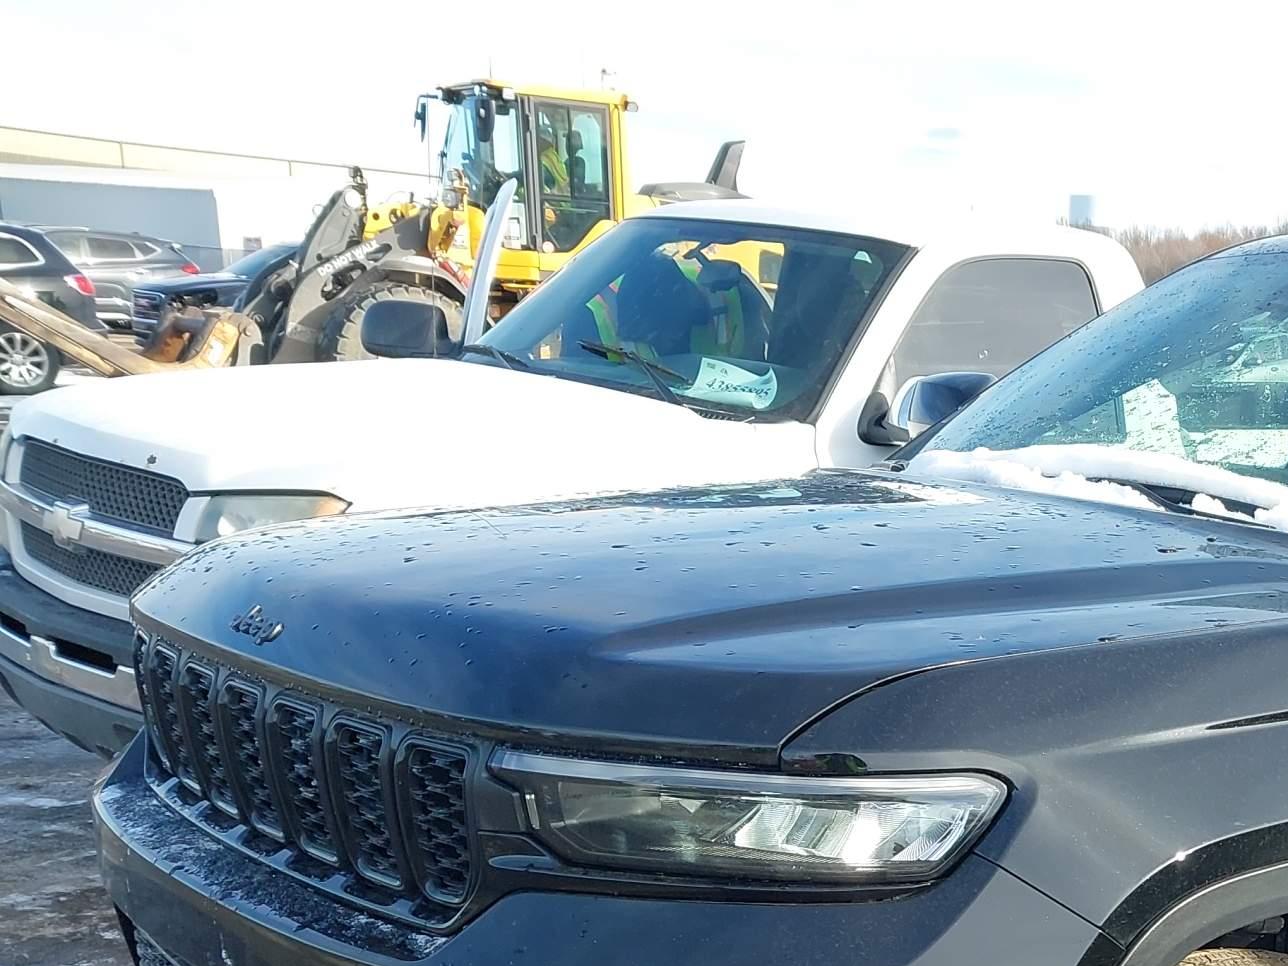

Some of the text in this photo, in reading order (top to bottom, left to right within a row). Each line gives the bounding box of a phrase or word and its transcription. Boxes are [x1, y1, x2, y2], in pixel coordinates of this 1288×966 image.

[317, 240, 380, 277] DO NOT WALK
[231, 603, 284, 646] Jeep
